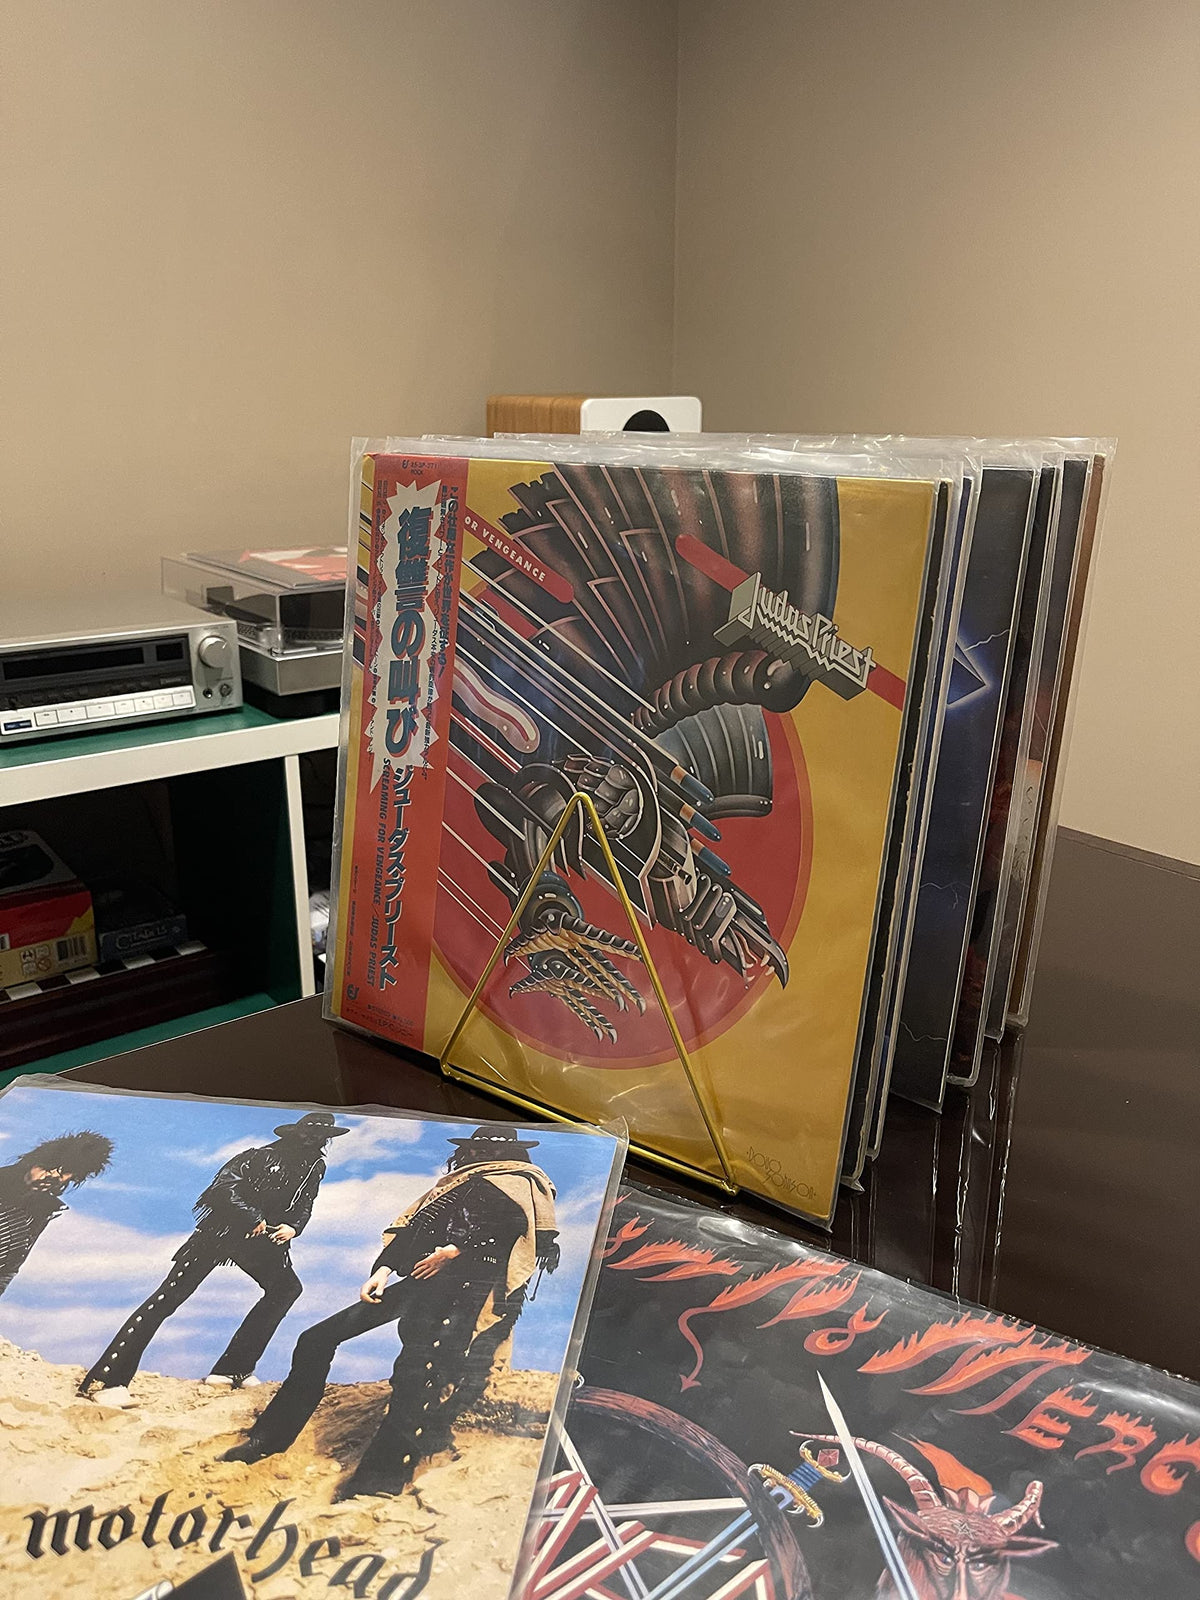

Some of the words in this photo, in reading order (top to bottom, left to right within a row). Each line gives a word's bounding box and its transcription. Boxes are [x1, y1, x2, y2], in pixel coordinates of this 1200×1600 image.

[482, 528, 547, 582] VENGEANCE
[738, 571, 812, 642] Judas
[811, 611, 877, 690] Priest
[379, 757, 392, 820] SCREAMING
[377, 822, 387, 844] FOR
[373, 846, 385, 906] VENGEANCE
[369, 916, 379, 949] JUDAS
[367, 951, 377, 987] PRIEST
